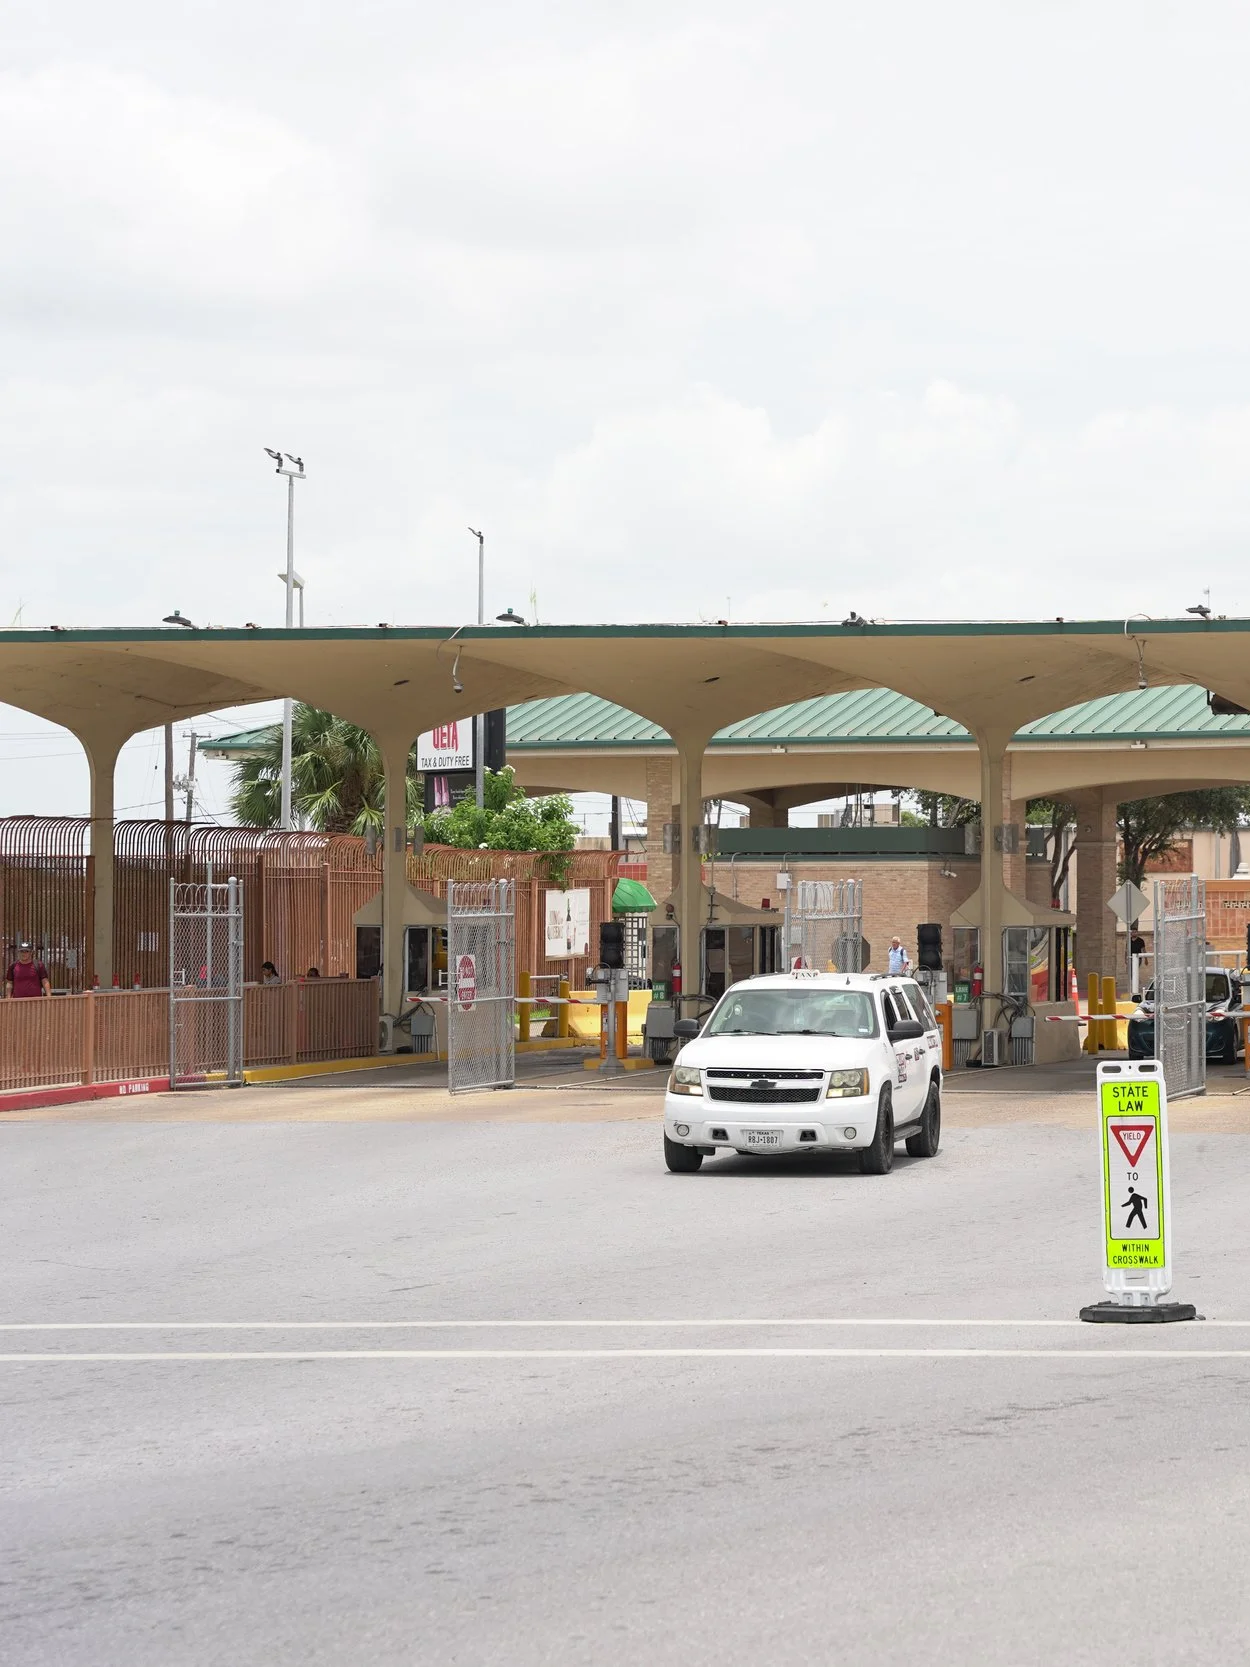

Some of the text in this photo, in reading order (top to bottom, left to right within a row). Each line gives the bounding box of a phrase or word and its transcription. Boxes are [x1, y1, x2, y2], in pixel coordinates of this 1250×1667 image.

[421, 755, 470, 768] TAX & DUTY FREE
[119, 1083, 149, 1094] NO PARKING
[1113, 1086, 1149, 1098] STATE
[1118, 1101, 1143, 1112] LAW
[1123, 1132, 1141, 1140] YIELD
[1127, 1172, 1139, 1181] TO
[1122, 1244, 1150, 1252] WITHIN
[1113, 1255, 1159, 1265] CROSSWALK
